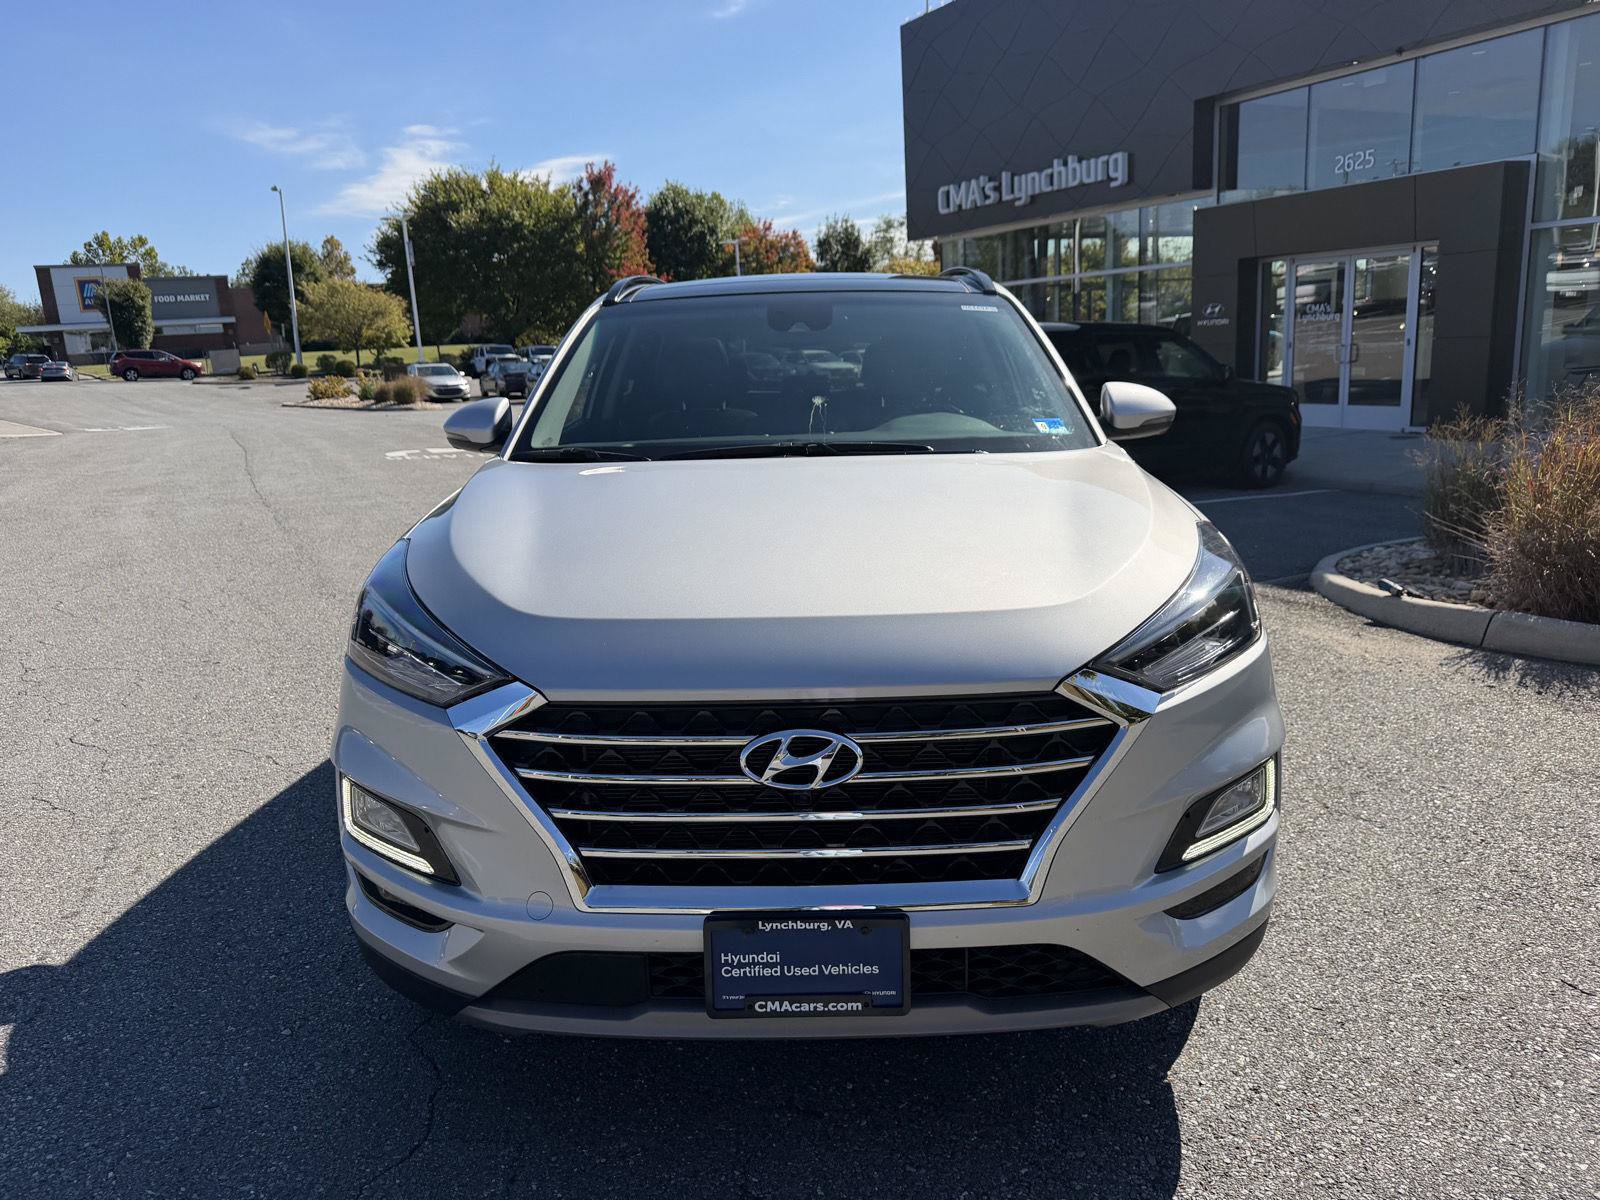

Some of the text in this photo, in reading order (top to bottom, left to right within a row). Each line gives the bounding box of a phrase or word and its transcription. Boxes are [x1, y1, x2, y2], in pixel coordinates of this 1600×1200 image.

[1335, 149, 1375, 173] 2625
[938, 151, 1129, 215] CMA's Lynchburg
[154, 293, 210, 303] FOOD MARKET
[1306, 302, 1331, 313] CMA's
[758, 920, 854, 931] Lynchburg, VA
[721, 952, 780, 965] Hyundai
[721, 963, 880, 977] Certified Used Vehicles
[754, 1000, 863, 1012] CMAcars.com
